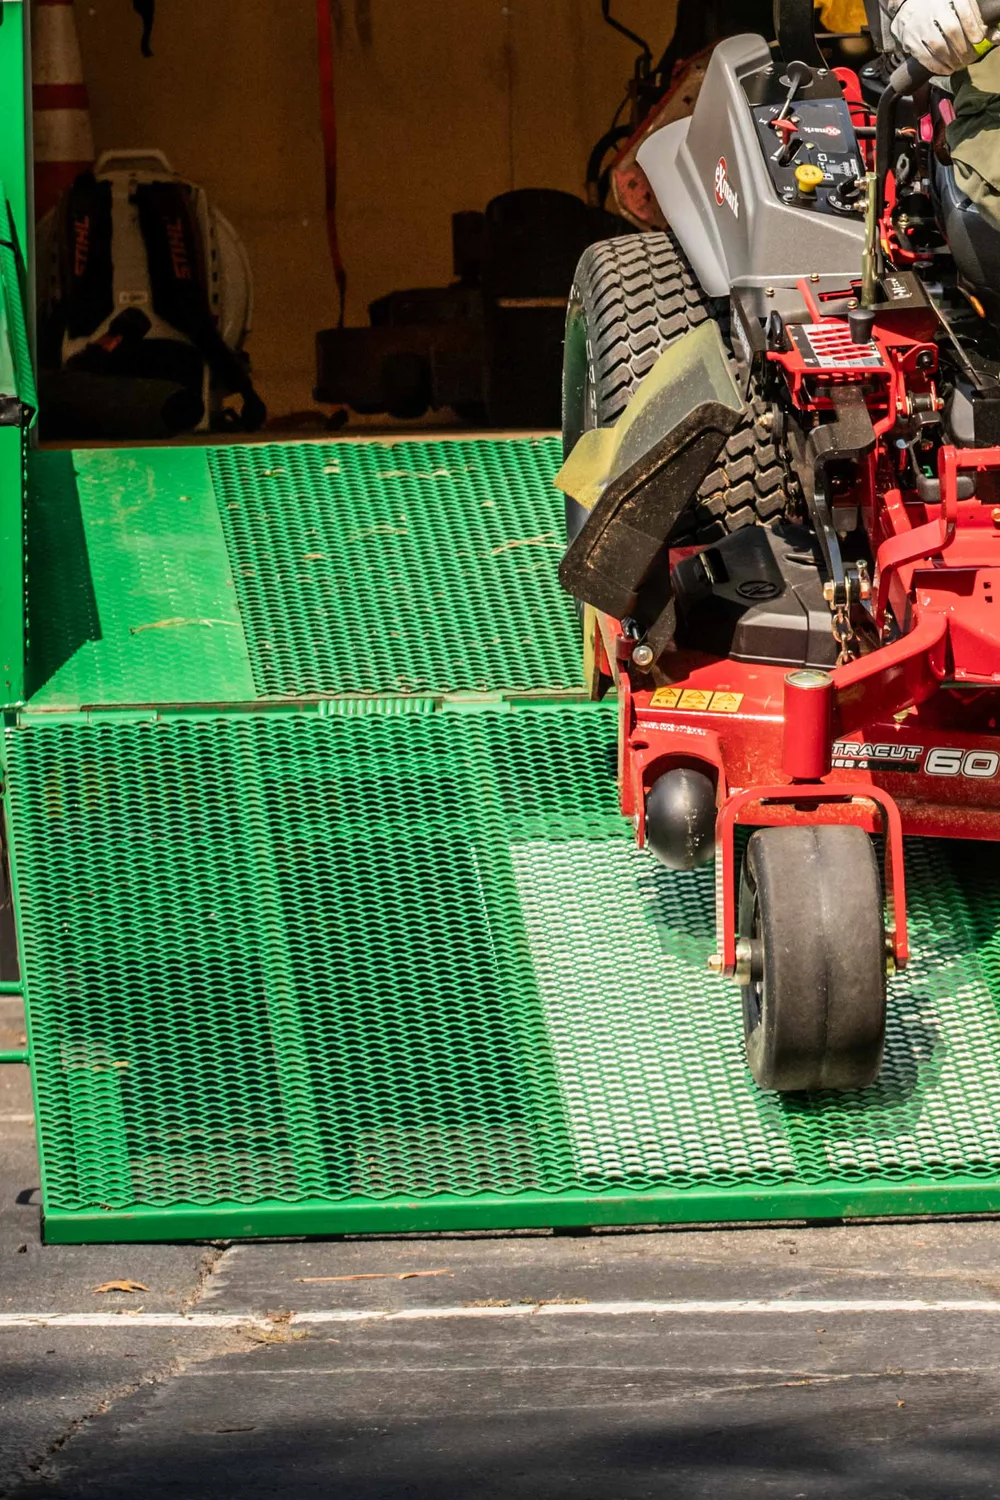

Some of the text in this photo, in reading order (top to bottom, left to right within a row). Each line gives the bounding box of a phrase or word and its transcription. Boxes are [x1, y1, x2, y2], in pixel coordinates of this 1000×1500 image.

[73, 214, 90, 278] STIHL
[166, 216, 191, 281] STIHL
[832, 742, 1000, 777] TRACUT 60
[832, 760, 855, 768] IES
